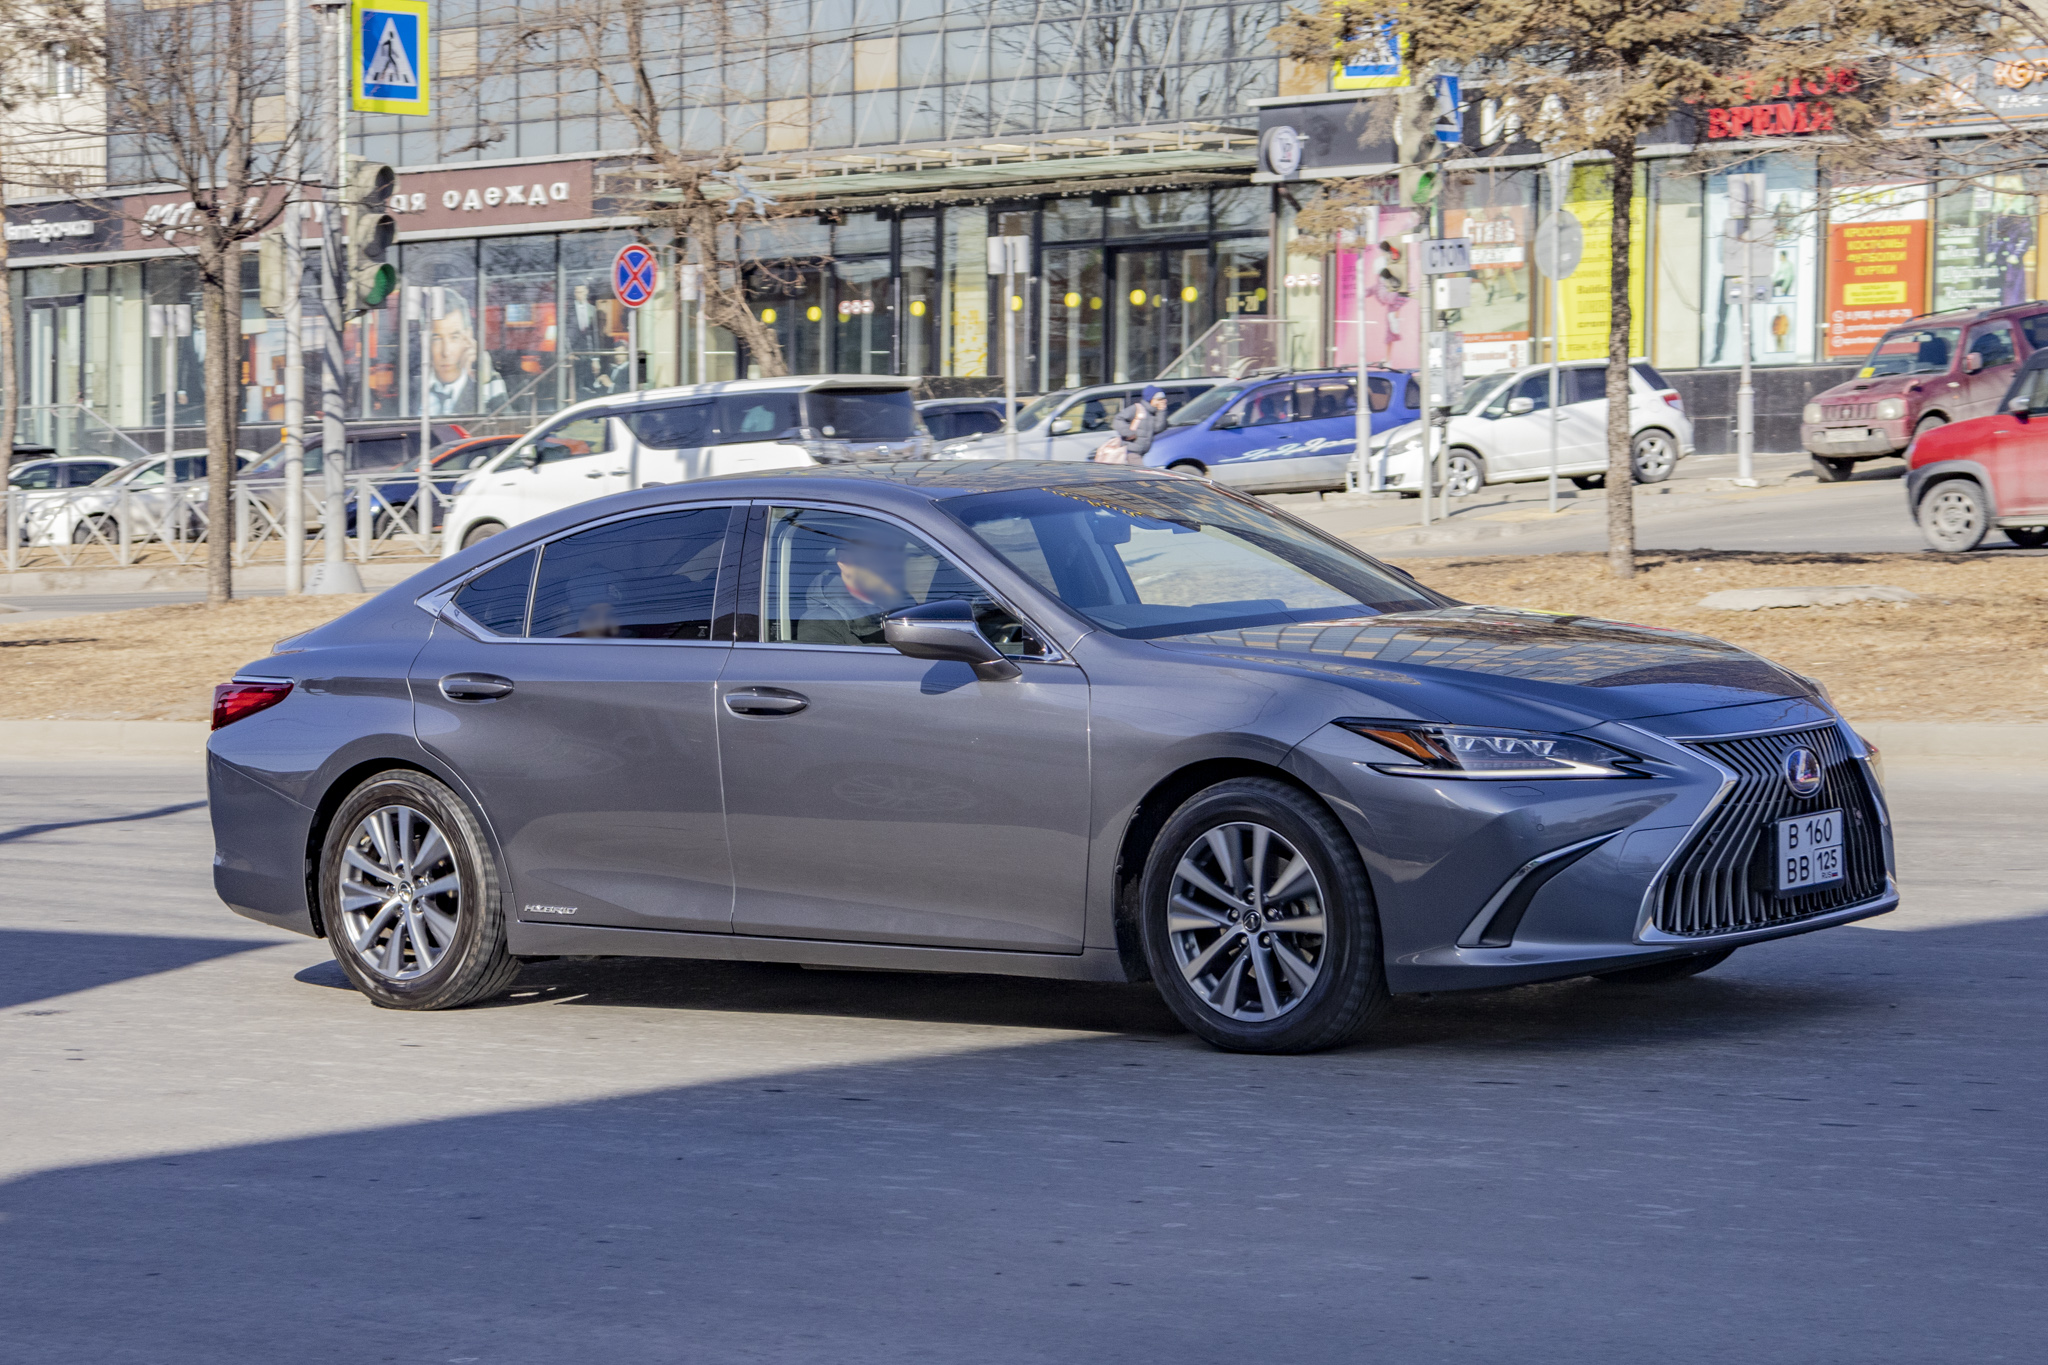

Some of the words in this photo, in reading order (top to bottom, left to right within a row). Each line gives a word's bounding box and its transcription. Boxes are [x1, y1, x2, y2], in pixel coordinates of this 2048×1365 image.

[1707, 101, 1833, 138] ВРЕМЯ
[442, 182, 570, 211] одежда
[1843, 225, 1912, 238] КРОССОВКИ
[1846, 251, 1908, 263] ФУТБОЛКИ
[1854, 264, 1898, 276] КУРТКИ
[1788, 823, 1799, 850] В
[1805, 817, 1832, 846] 160
[1787, 855, 1810, 884] ВВ
[1816, 850, 1838, 872] 125
[1821, 871, 1832, 879] RUS
[524, 904, 578, 915] HYBRID
